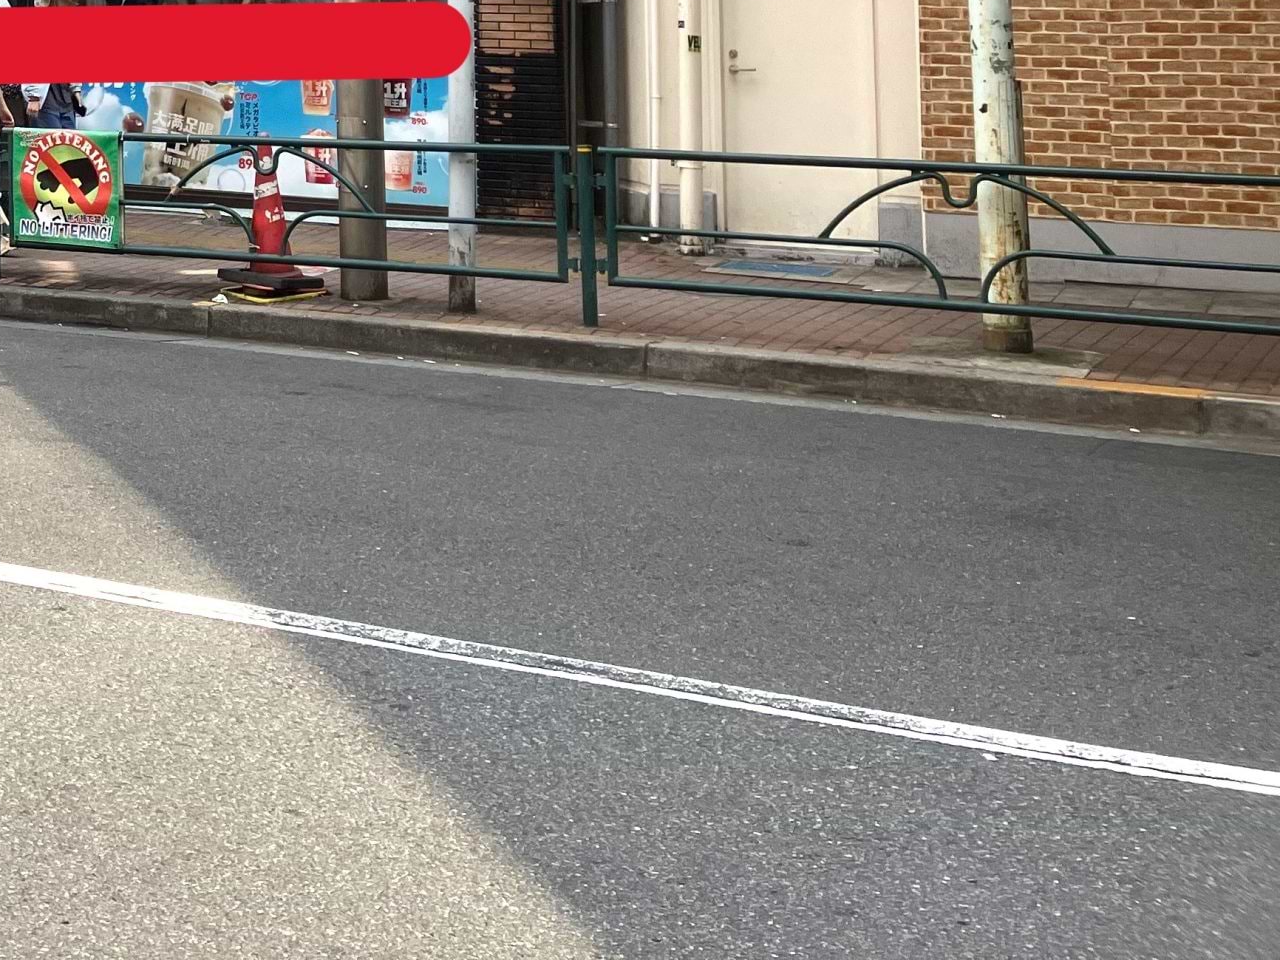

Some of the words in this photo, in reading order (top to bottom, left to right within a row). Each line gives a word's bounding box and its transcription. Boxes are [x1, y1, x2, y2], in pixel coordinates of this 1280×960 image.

[23, 150, 40, 175] NO
[38, 132, 110, 183] LITTERING
[20, 218, 38, 236] NO
[41, 221, 114, 240] LITTERING!
